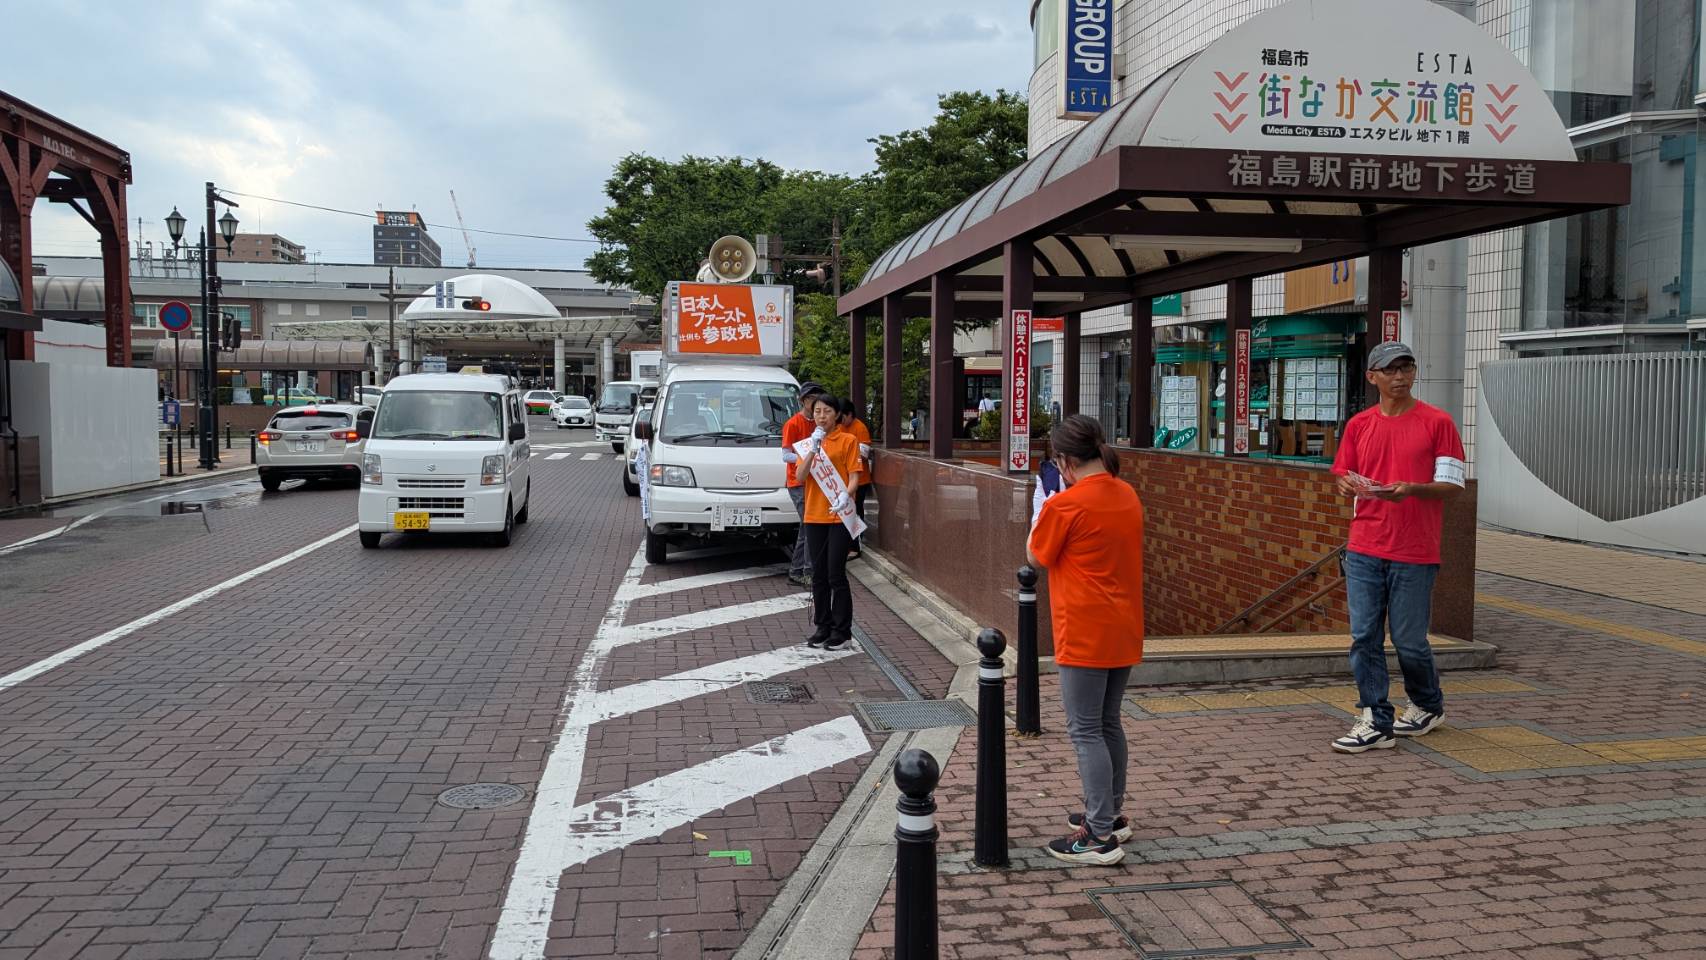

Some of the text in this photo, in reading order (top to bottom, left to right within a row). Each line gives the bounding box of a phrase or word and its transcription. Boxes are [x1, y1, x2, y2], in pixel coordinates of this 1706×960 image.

[1261, 48, 1309, 67] 福島市
[1417, 52, 1473, 75] ESTA
[1070, 90, 1108, 106] ESTA
[1258, 72, 1475, 126] 街なか交流館
[1266, 126, 1341, 136] Media City ESTA
[1349, 128, 1470, 144] エスタビル 地下1階
[1228, 153, 1537, 194] 福島駅前地下歩道
[680, 294, 724, 313] 日本人
[690, 307, 746, 327] ファースト
[702, 323, 754, 345] 参政党
[1015, 314, 1027, 424] 休憩スペースあります。
[1170, 428, 1195, 448] マンション
